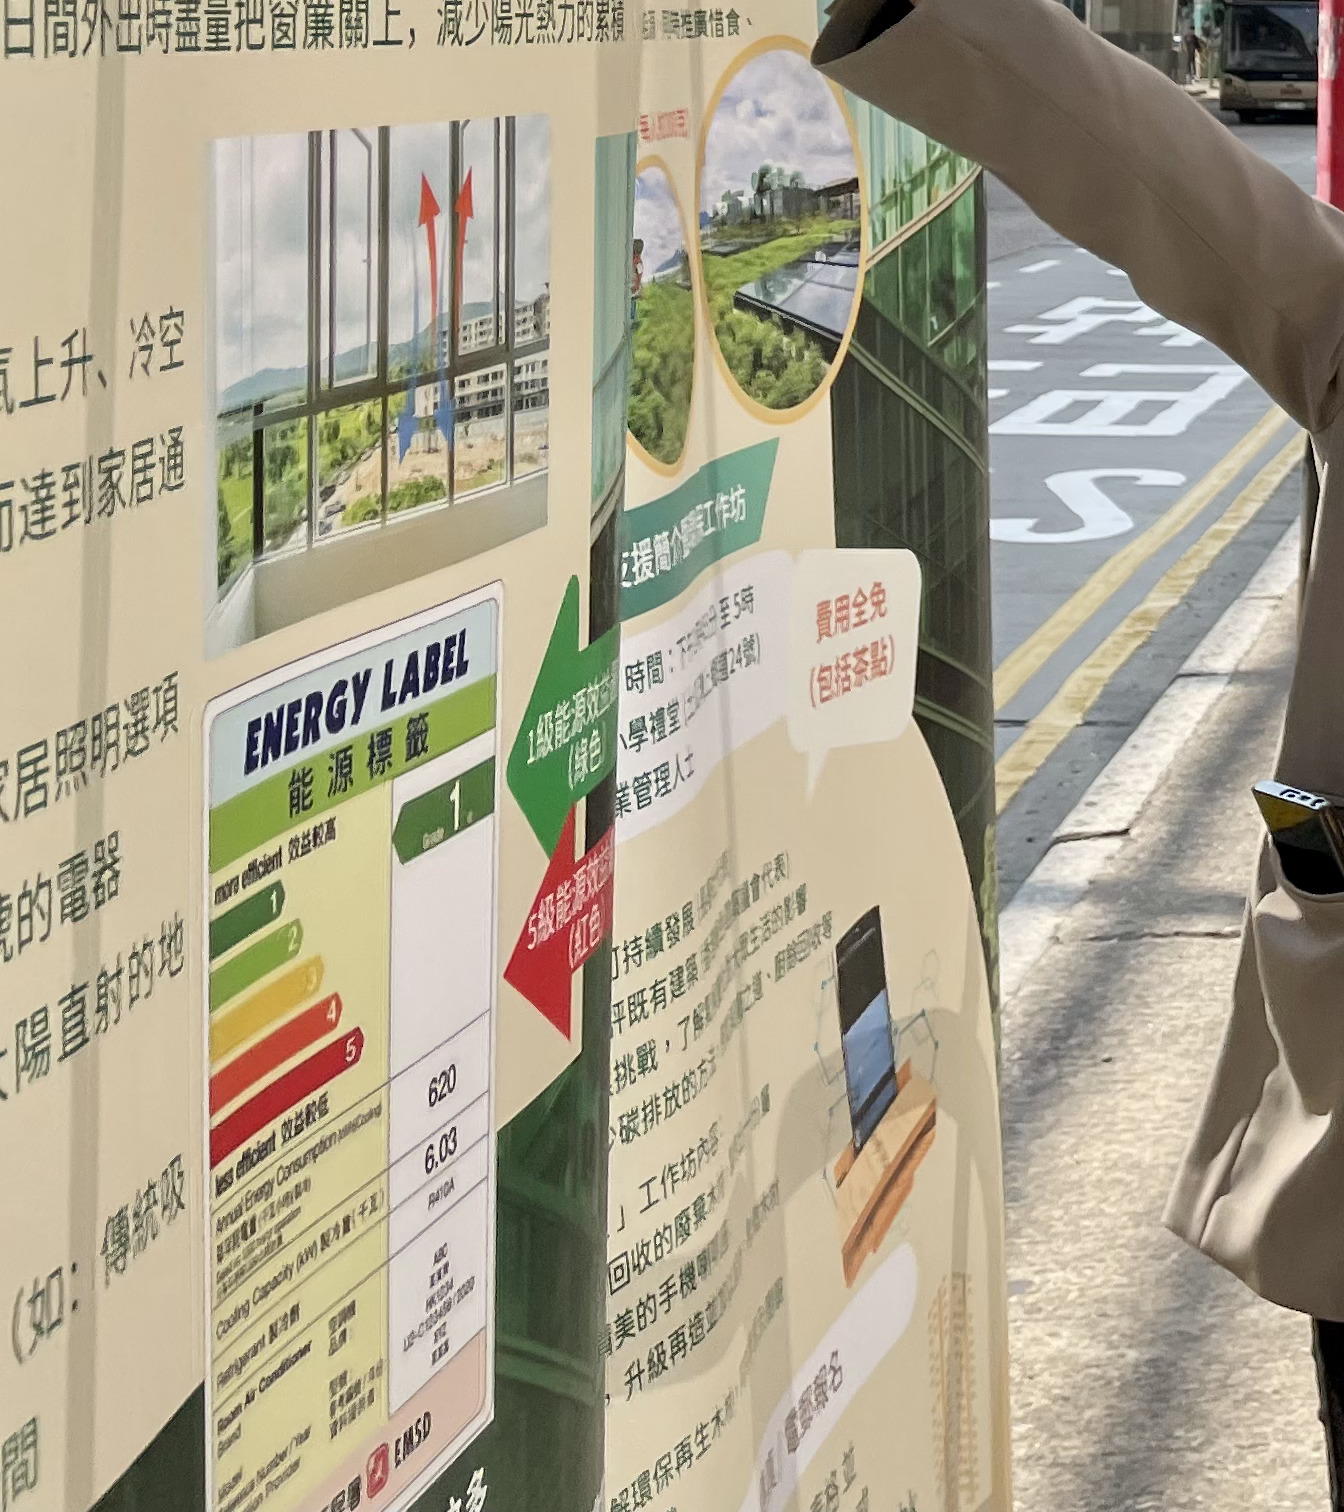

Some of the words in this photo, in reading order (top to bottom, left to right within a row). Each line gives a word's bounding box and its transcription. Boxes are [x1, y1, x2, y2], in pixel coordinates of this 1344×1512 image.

[243, 667, 373, 778] ENERGY
[380, 627, 470, 712] LABEL
[0, 670, 180, 822] 居照明選項
[448, 778, 463, 833] 1
[270, 889, 278, 915] 1
[288, 924, 300, 952] 2
[0, 911, 187, 1104] 陽直射的地
[325, 999, 338, 1023] 4
[344, 1037, 357, 1062] 5
[428, 1063, 457, 1108] 620
[424, 1125, 458, 1175] 6.03
[394, 1410, 432, 1470] EMSD
